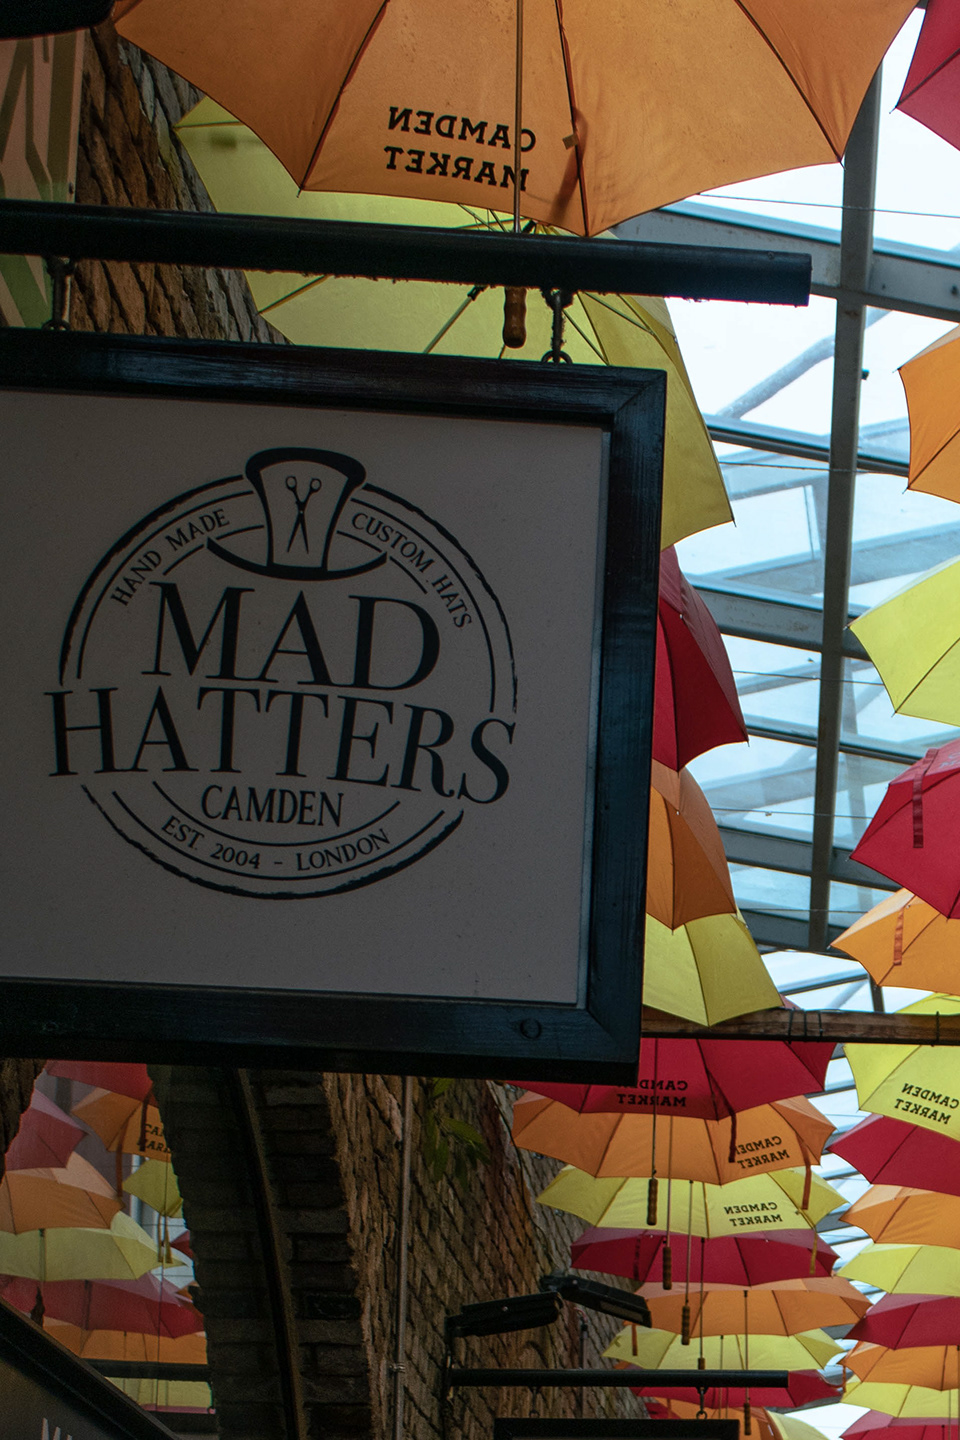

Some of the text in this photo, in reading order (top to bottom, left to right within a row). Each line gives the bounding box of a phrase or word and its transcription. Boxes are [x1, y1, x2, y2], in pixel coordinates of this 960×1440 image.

[111, 508, 230, 607] HAND MADE
[351, 512, 472, 629] CUSTOM HATS
[142, 582, 440, 690] MAD
[44, 685, 516, 804] HATTERS
[161, 814, 202, 851] EST.
[211, 842, 260, 869] 2004
[296, 827, 391, 870] LONDON
[201, 784, 344, 828] CAMDEN
